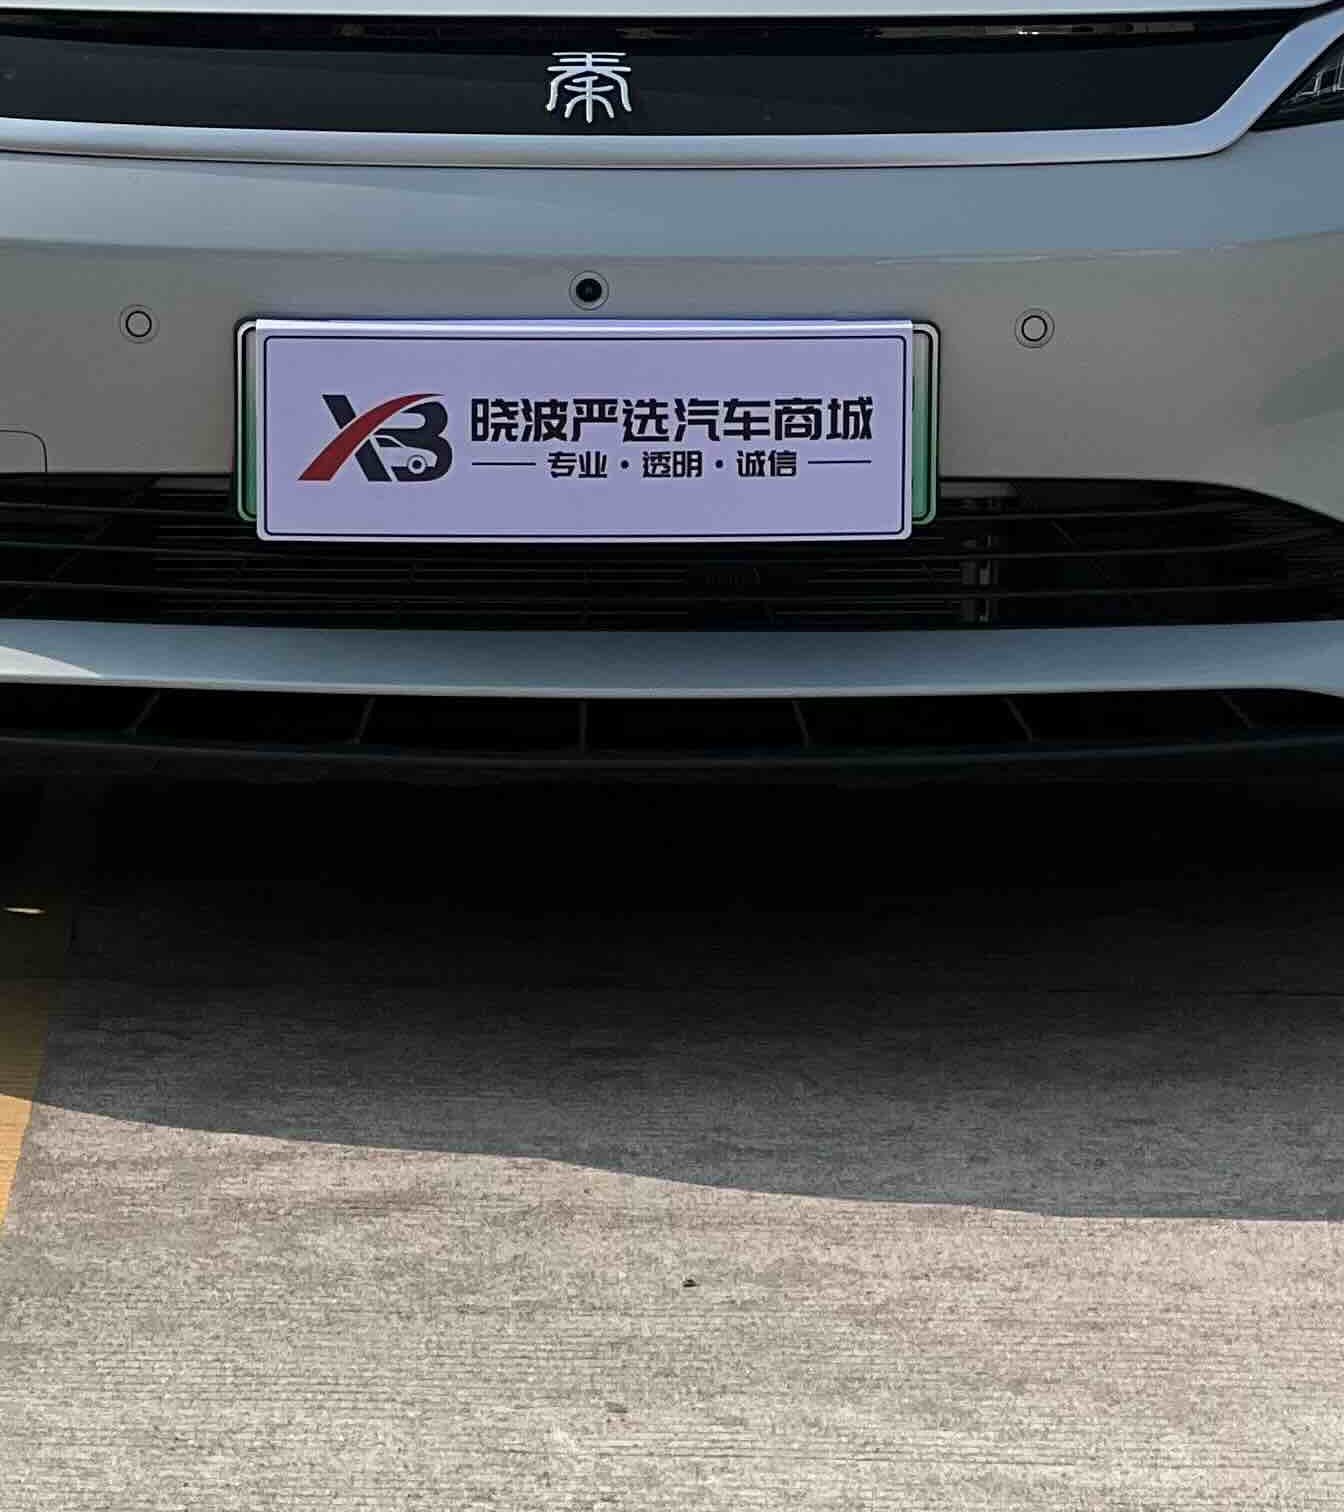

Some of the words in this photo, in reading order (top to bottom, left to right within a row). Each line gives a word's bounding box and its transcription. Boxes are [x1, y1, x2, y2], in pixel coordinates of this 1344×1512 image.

[545, 51, 633, 124] 秦
[471, 395, 874, 443] 晓波严选汽车商城
